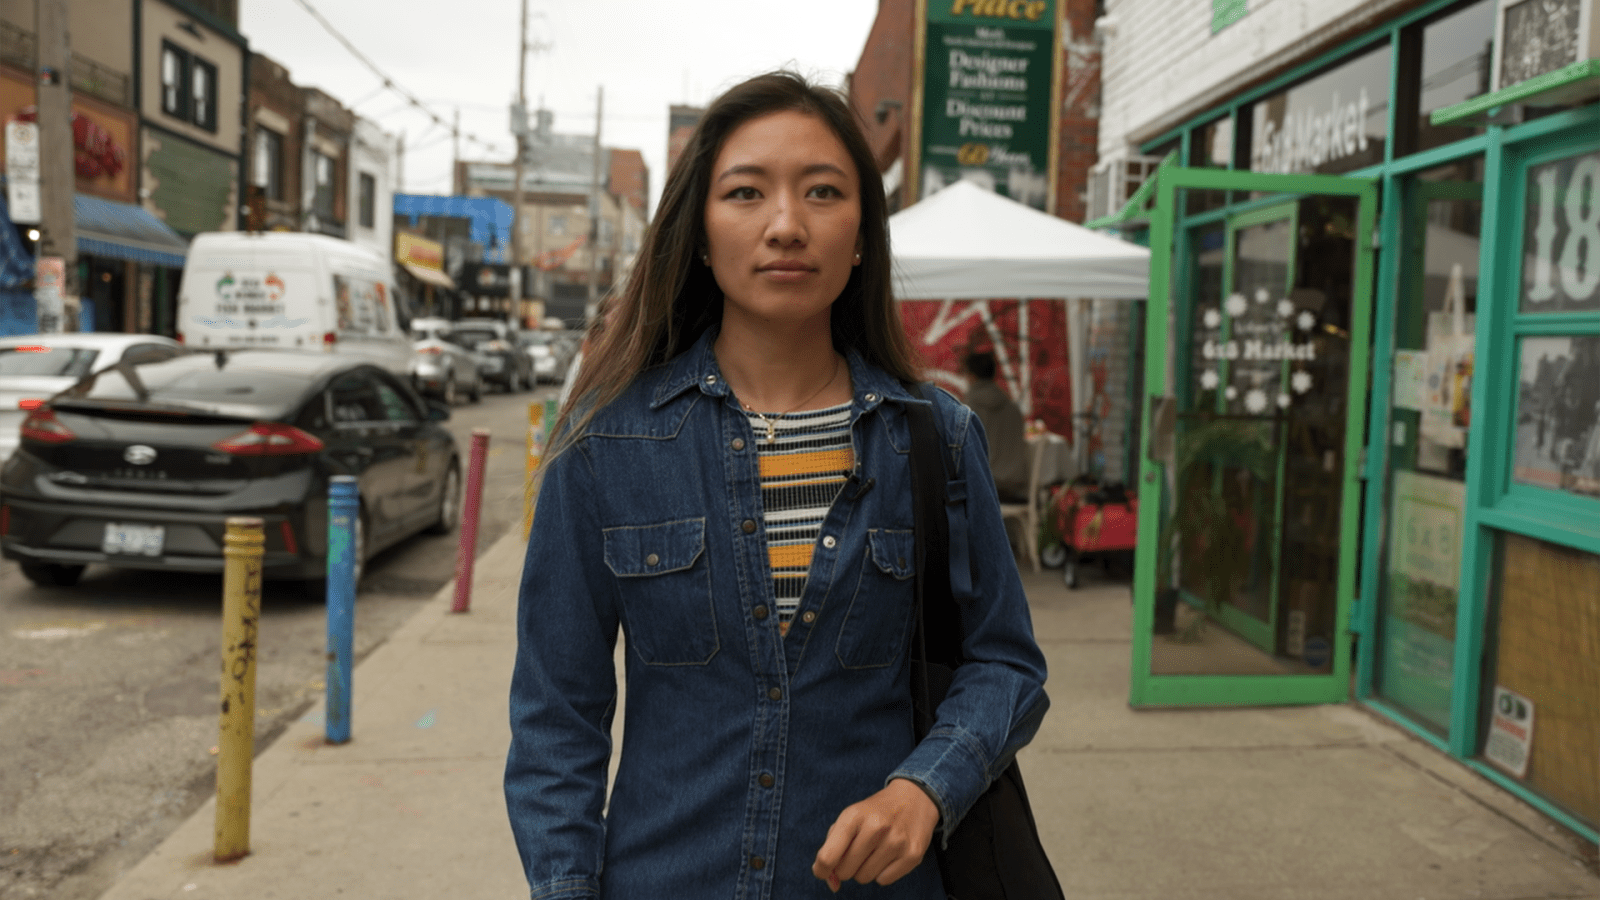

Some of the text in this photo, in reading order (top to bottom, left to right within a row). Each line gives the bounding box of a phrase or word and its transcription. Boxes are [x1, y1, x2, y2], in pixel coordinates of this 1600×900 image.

[949, 50, 1029, 76] Designer
[949, 70, 1028, 91] Fashions
[946, 98, 1027, 121] Discount
[959, 118, 1014, 139] Prices
[1243, 339, 1316, 360] Market
